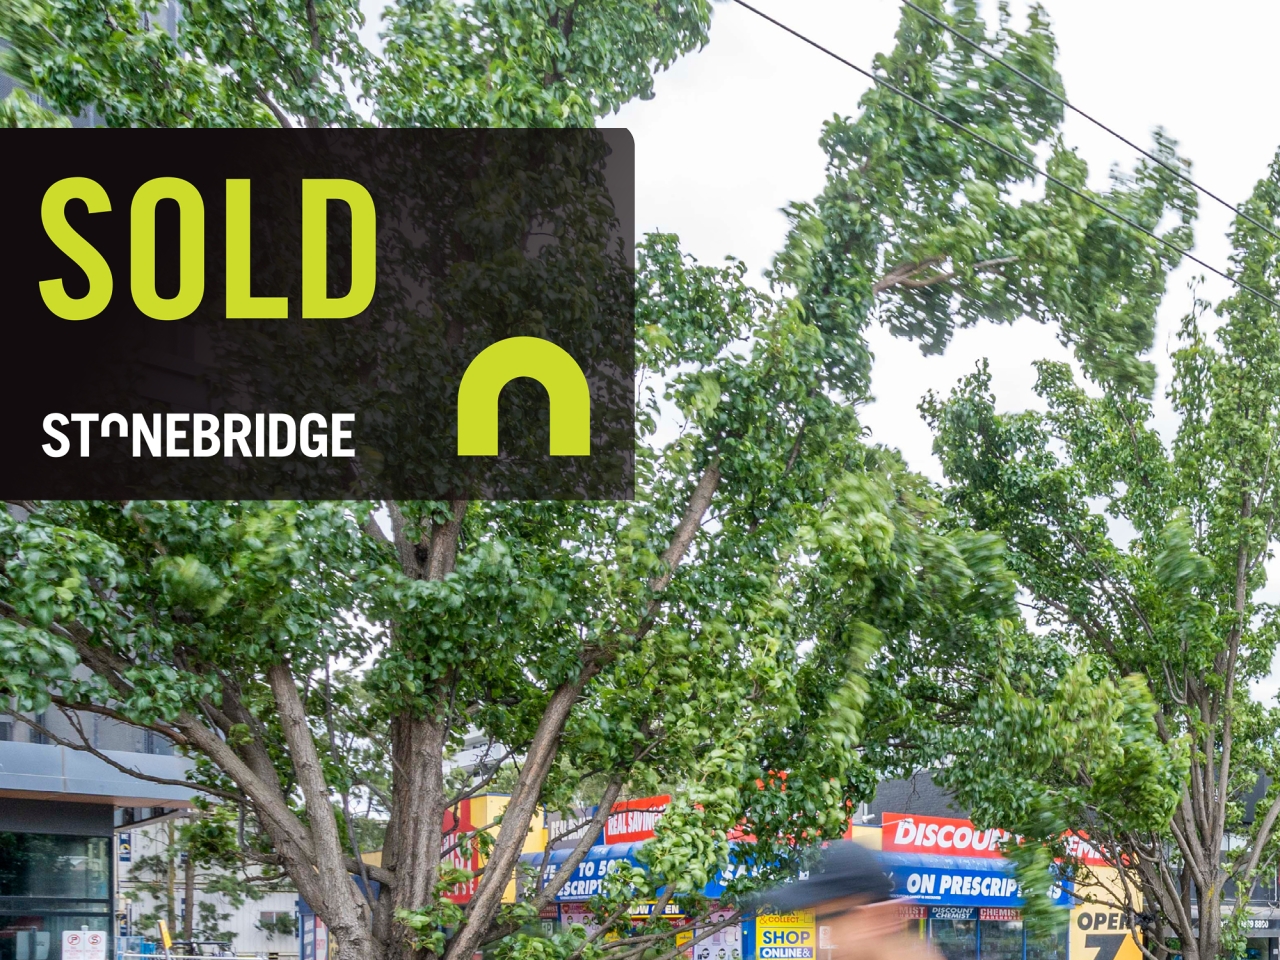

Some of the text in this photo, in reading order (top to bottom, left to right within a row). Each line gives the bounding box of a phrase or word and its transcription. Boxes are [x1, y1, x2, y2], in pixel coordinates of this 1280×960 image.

[608, 804, 666, 835] REAL SAVING
[578, 861, 595, 877] TO
[907, 873, 936, 894] ON
[932, 906, 974, 914] DISCOUNT
[980, 907, 1022, 916] CHEMIST
[763, 930, 810, 945] SHOP
